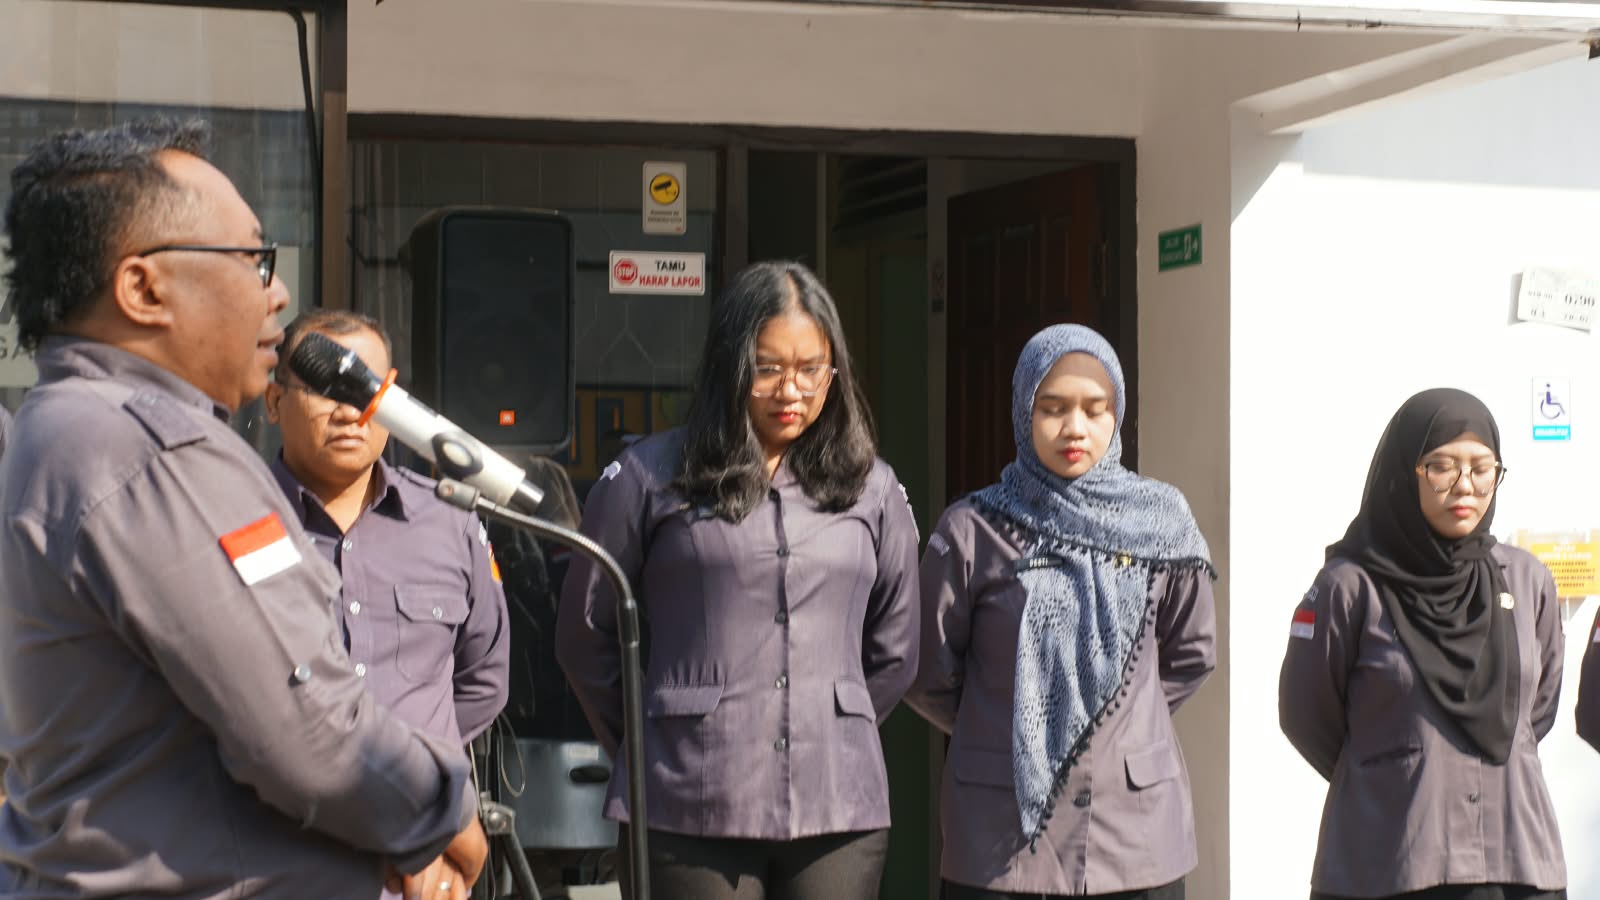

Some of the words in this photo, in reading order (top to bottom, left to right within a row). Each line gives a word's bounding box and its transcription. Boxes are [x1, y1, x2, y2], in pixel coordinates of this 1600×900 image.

[655, 260, 686, 272] TAMU
[639, 274, 669, 287] HARAP
[671, 275, 700, 288] LAPOR
